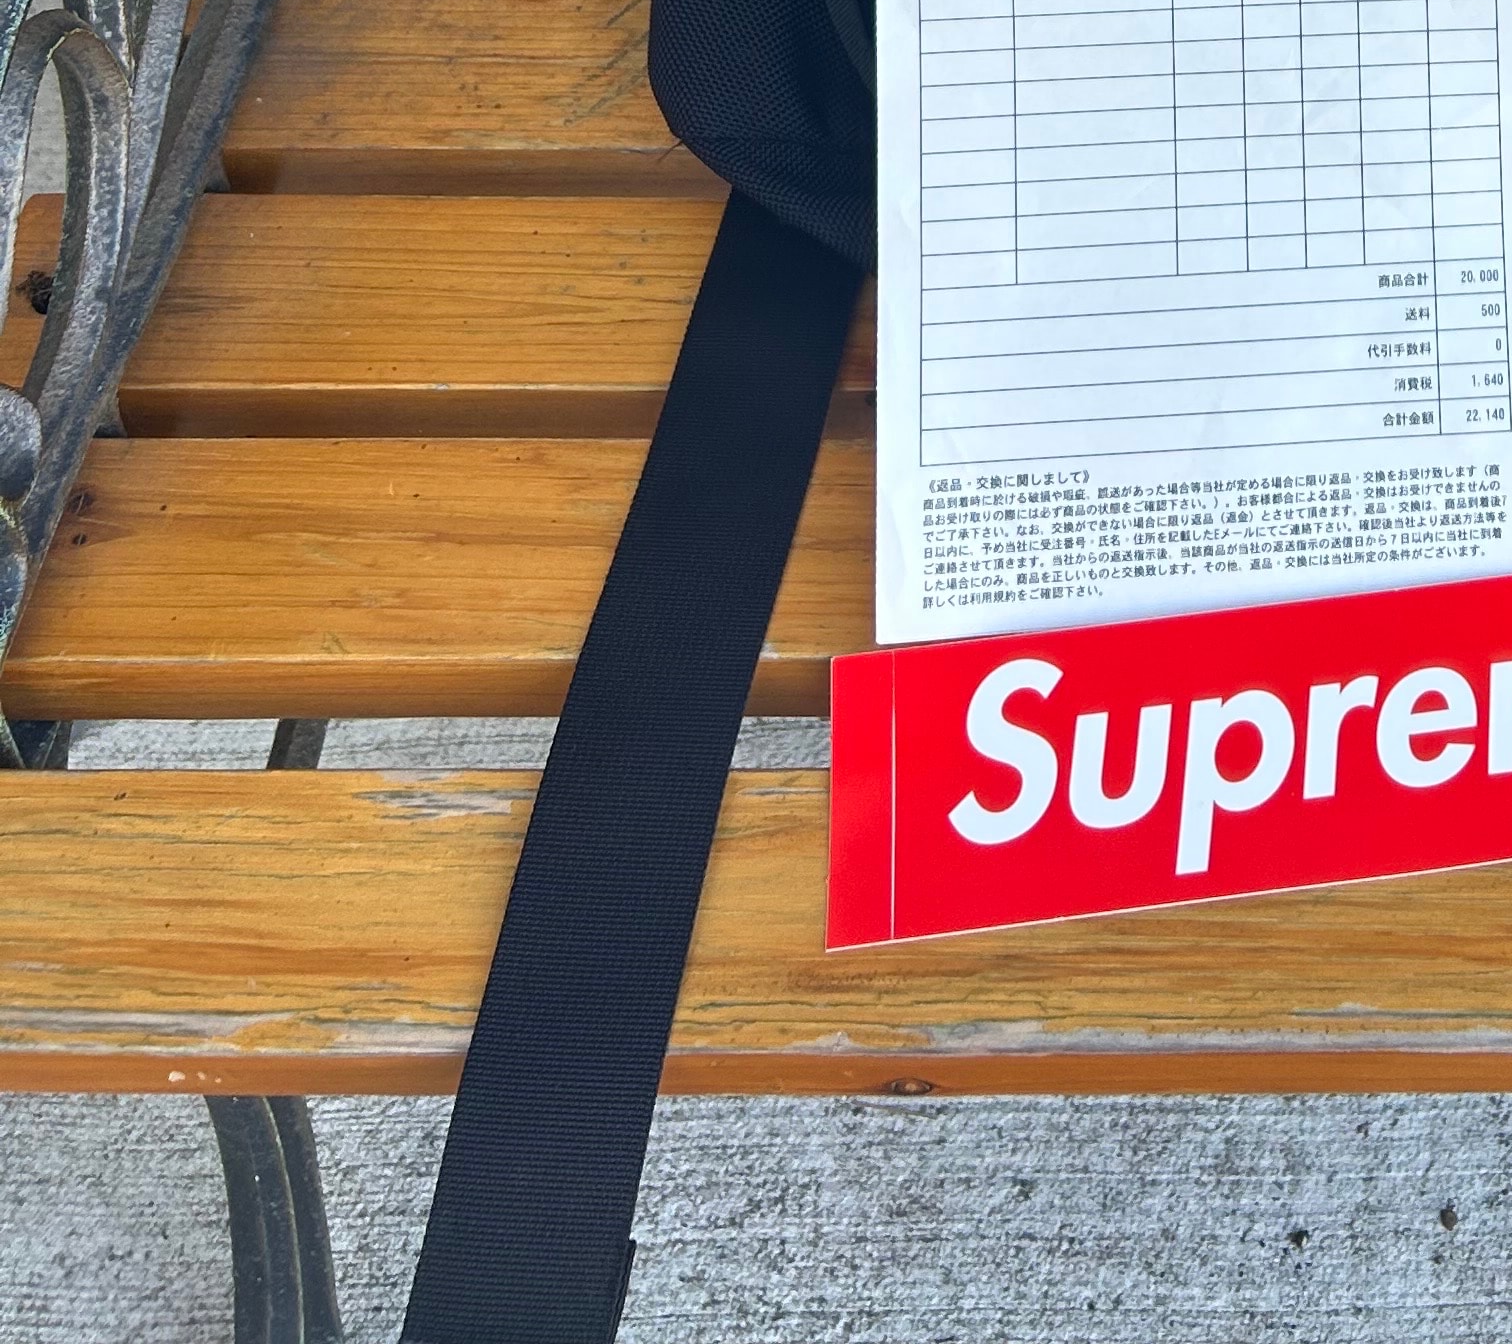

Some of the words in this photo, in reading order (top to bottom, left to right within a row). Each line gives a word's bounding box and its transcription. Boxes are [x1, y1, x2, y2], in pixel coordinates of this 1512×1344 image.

[1378, 272, 1428, 288] 商品合計
[1461, 269, 1499, 284] 20,000
[1405, 307, 1429, 321] 送料
[1481, 303, 1501, 316] 500
[1368, 341, 1431, 358] 代引手数料
[1394, 376, 1432, 391] 消費税
[1471, 373, 1504, 387] 1,640
[1383, 411, 1434, 426] 合計金額
[1466, 407, 1505, 422] 22,140
